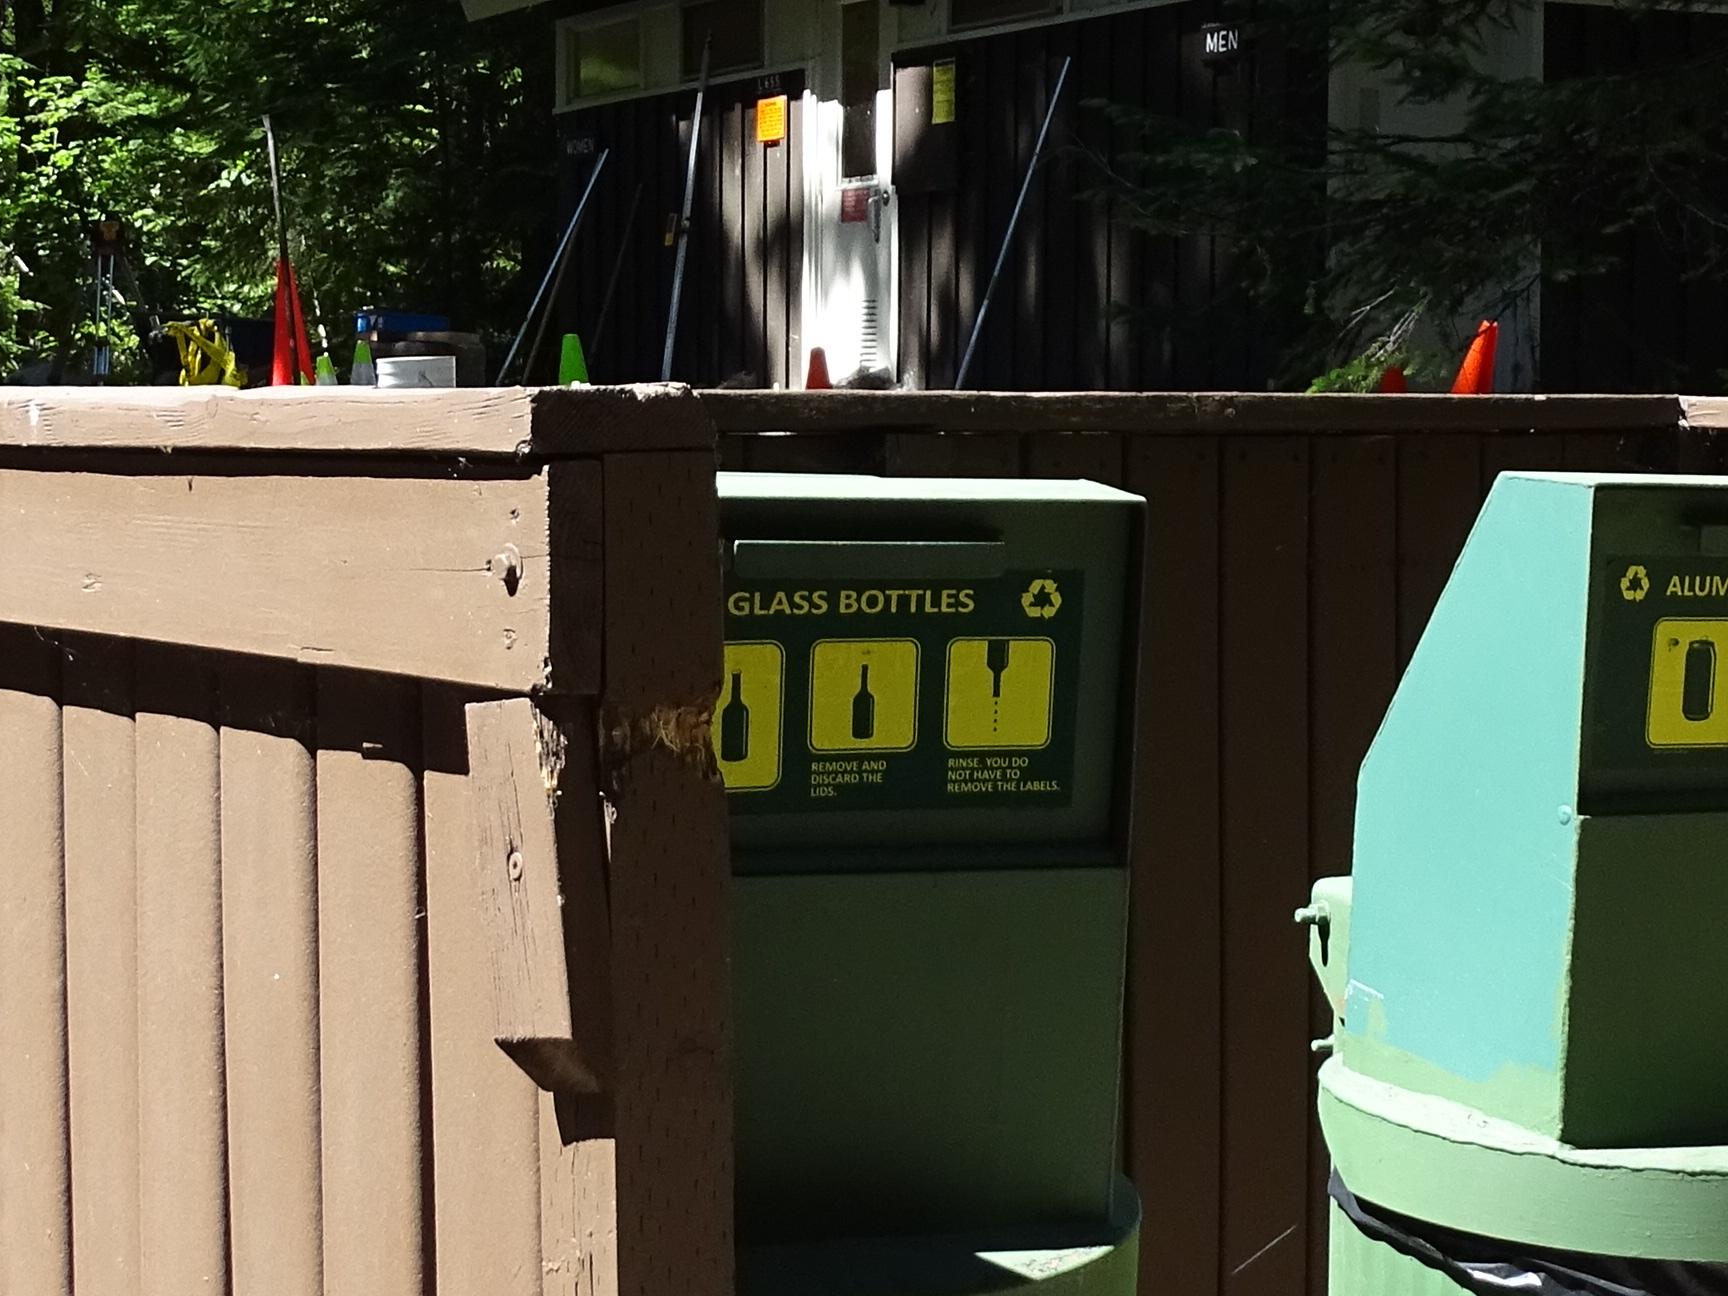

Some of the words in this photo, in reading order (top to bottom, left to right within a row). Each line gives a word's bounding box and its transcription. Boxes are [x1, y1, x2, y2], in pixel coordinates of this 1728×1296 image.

[1206, 29, 1238, 53] MEN
[727, 590, 828, 616] GLASS
[838, 589, 975, 615] BOTTLES
[811, 761, 859, 772] REMOVE
[861, 760, 887, 771] AND
[948, 757, 983, 768] RINSE.
[985, 757, 1009, 767] YOU
[1011, 757, 1029, 767] DO
[811, 773, 860, 784] DISCARD
[862, 772, 884, 783] THE
[947, 770, 971, 780] NOT
[973, 769, 1003, 780] HAVE
[1005, 769, 1021, 779] TO
[810, 786, 838, 797] LIDS.
[947, 782, 994, 793] REMOVE
[997, 781, 1018, 792] THE
[1019, 780, 1061, 791] LABELS.
